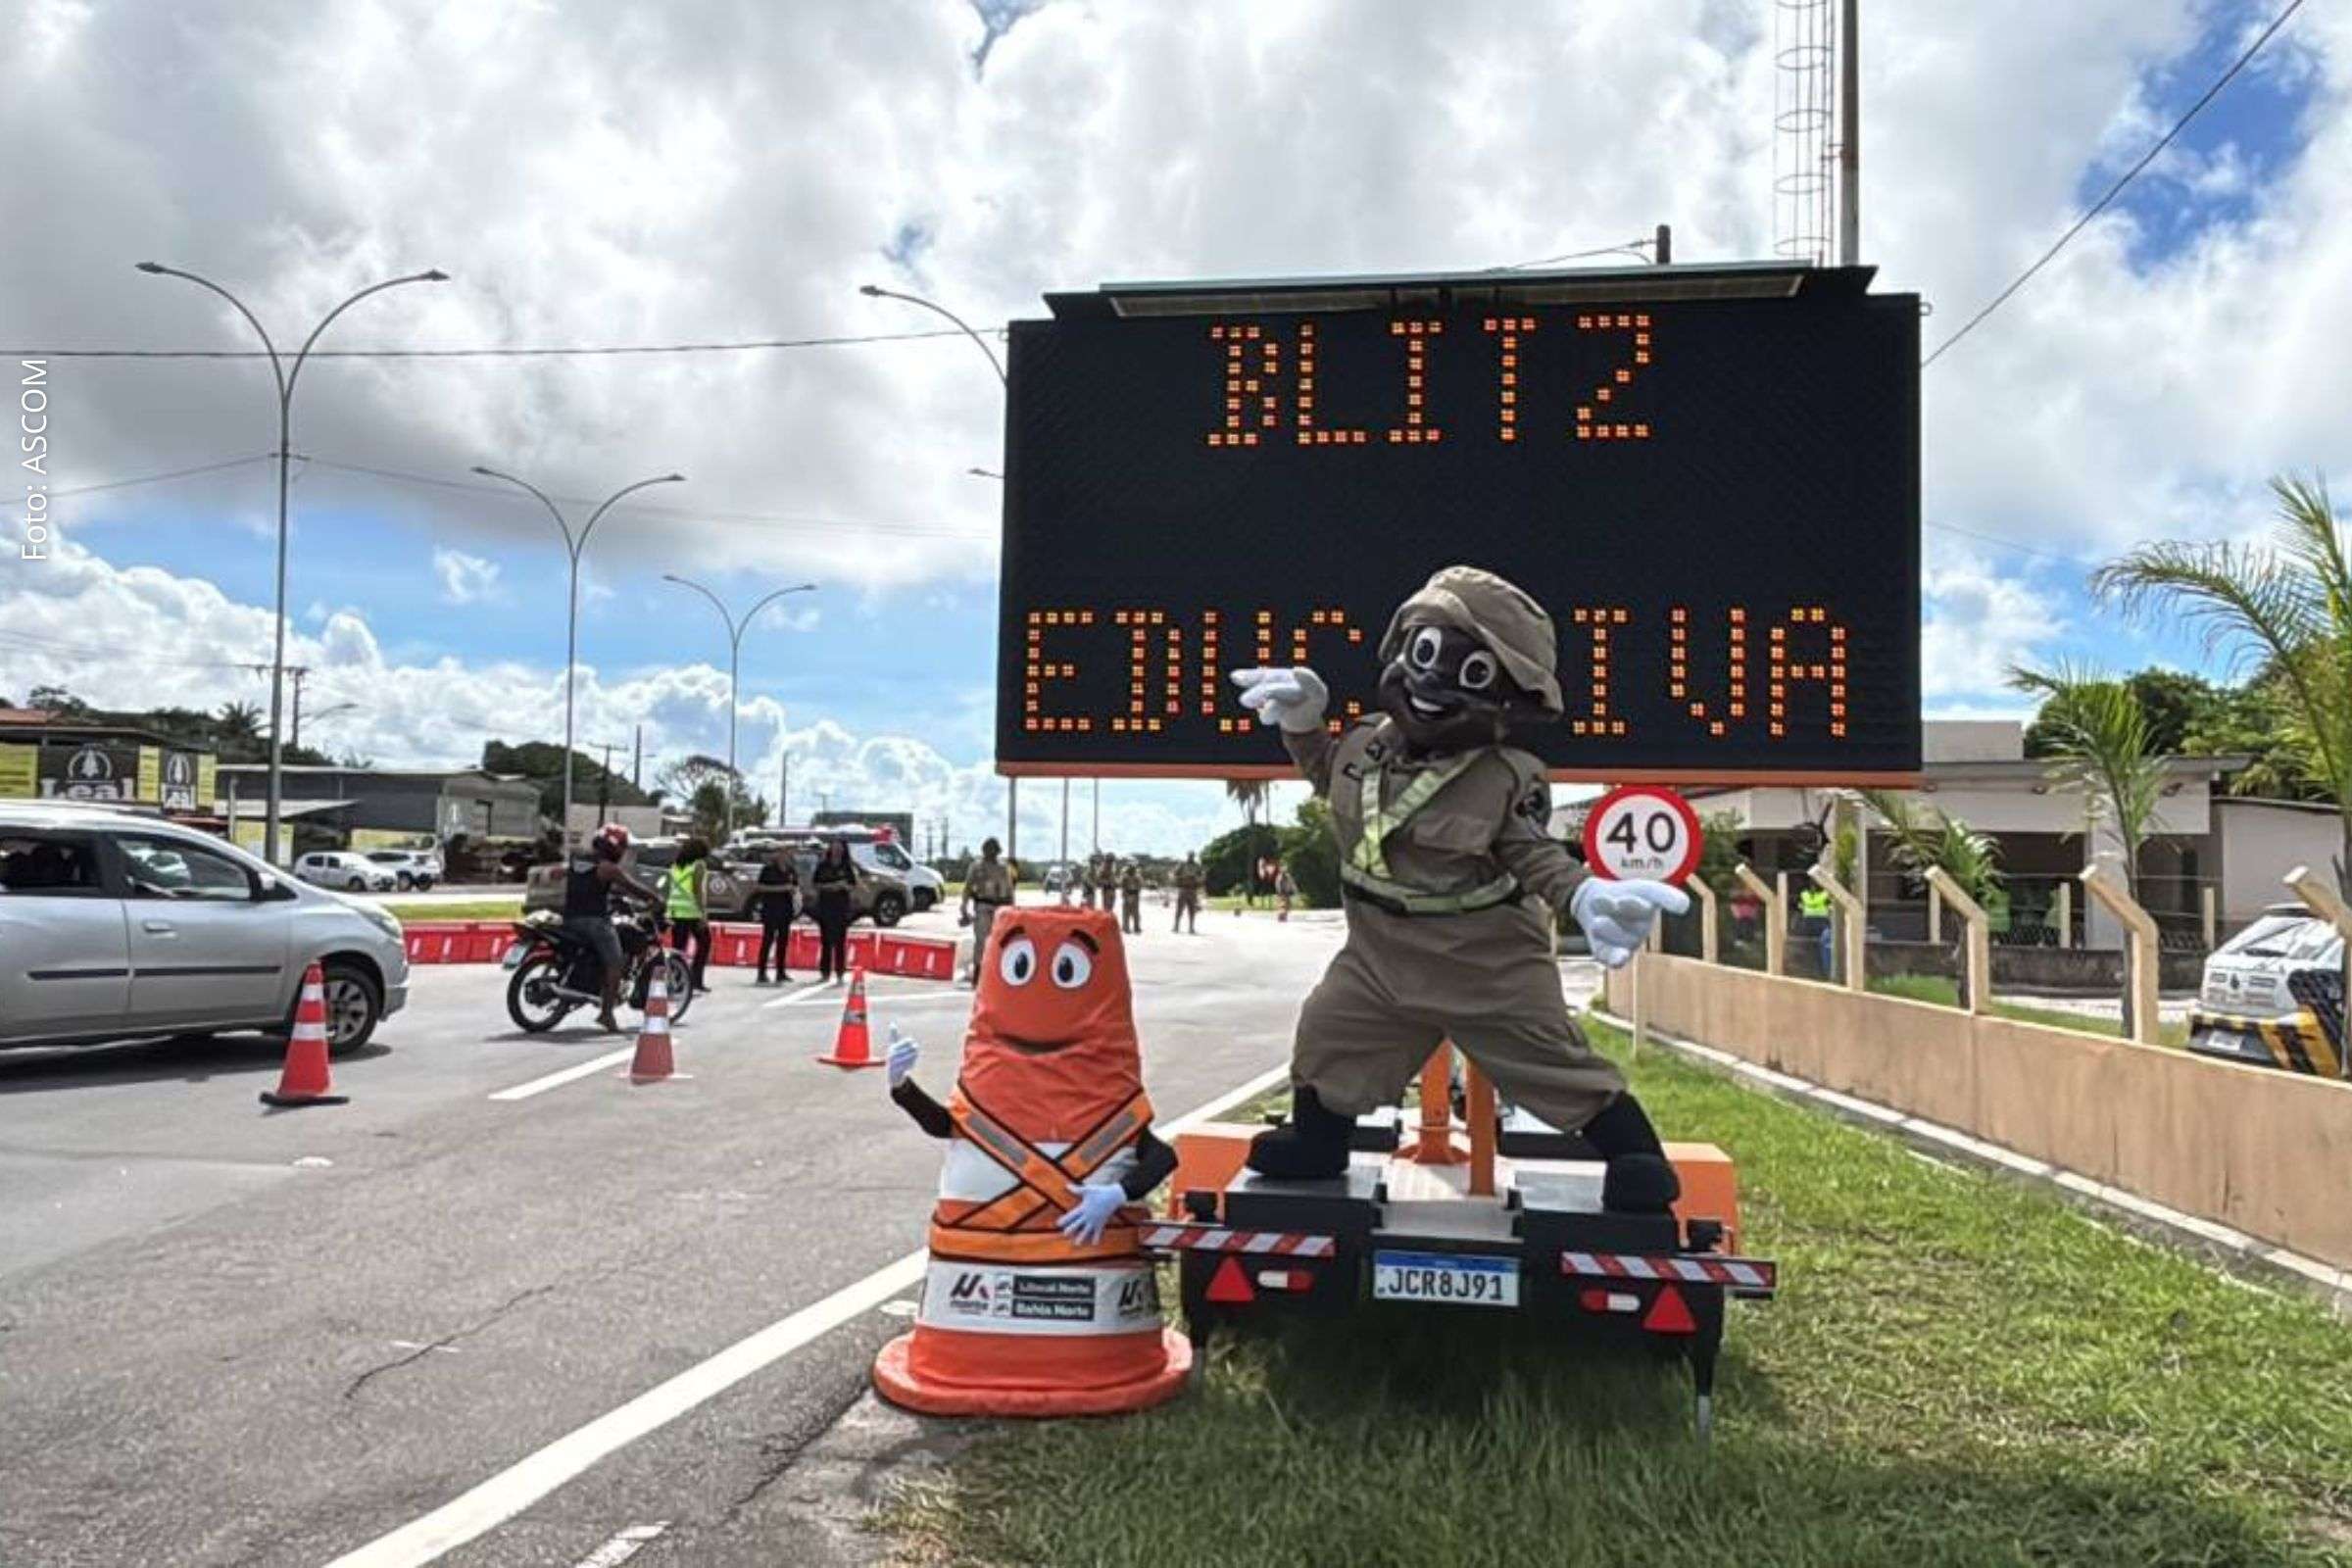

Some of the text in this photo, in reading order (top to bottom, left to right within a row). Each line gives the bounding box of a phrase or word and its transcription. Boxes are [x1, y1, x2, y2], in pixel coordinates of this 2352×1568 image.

[1207, 314, 1651, 447] BLITZ
[1025, 609, 1846, 736] EDUCIVA
[1605, 811, 1677, 854] 40
[1621, 856, 1664, 870] km/h
[1388, 1267, 1504, 1300] JCR8J91
